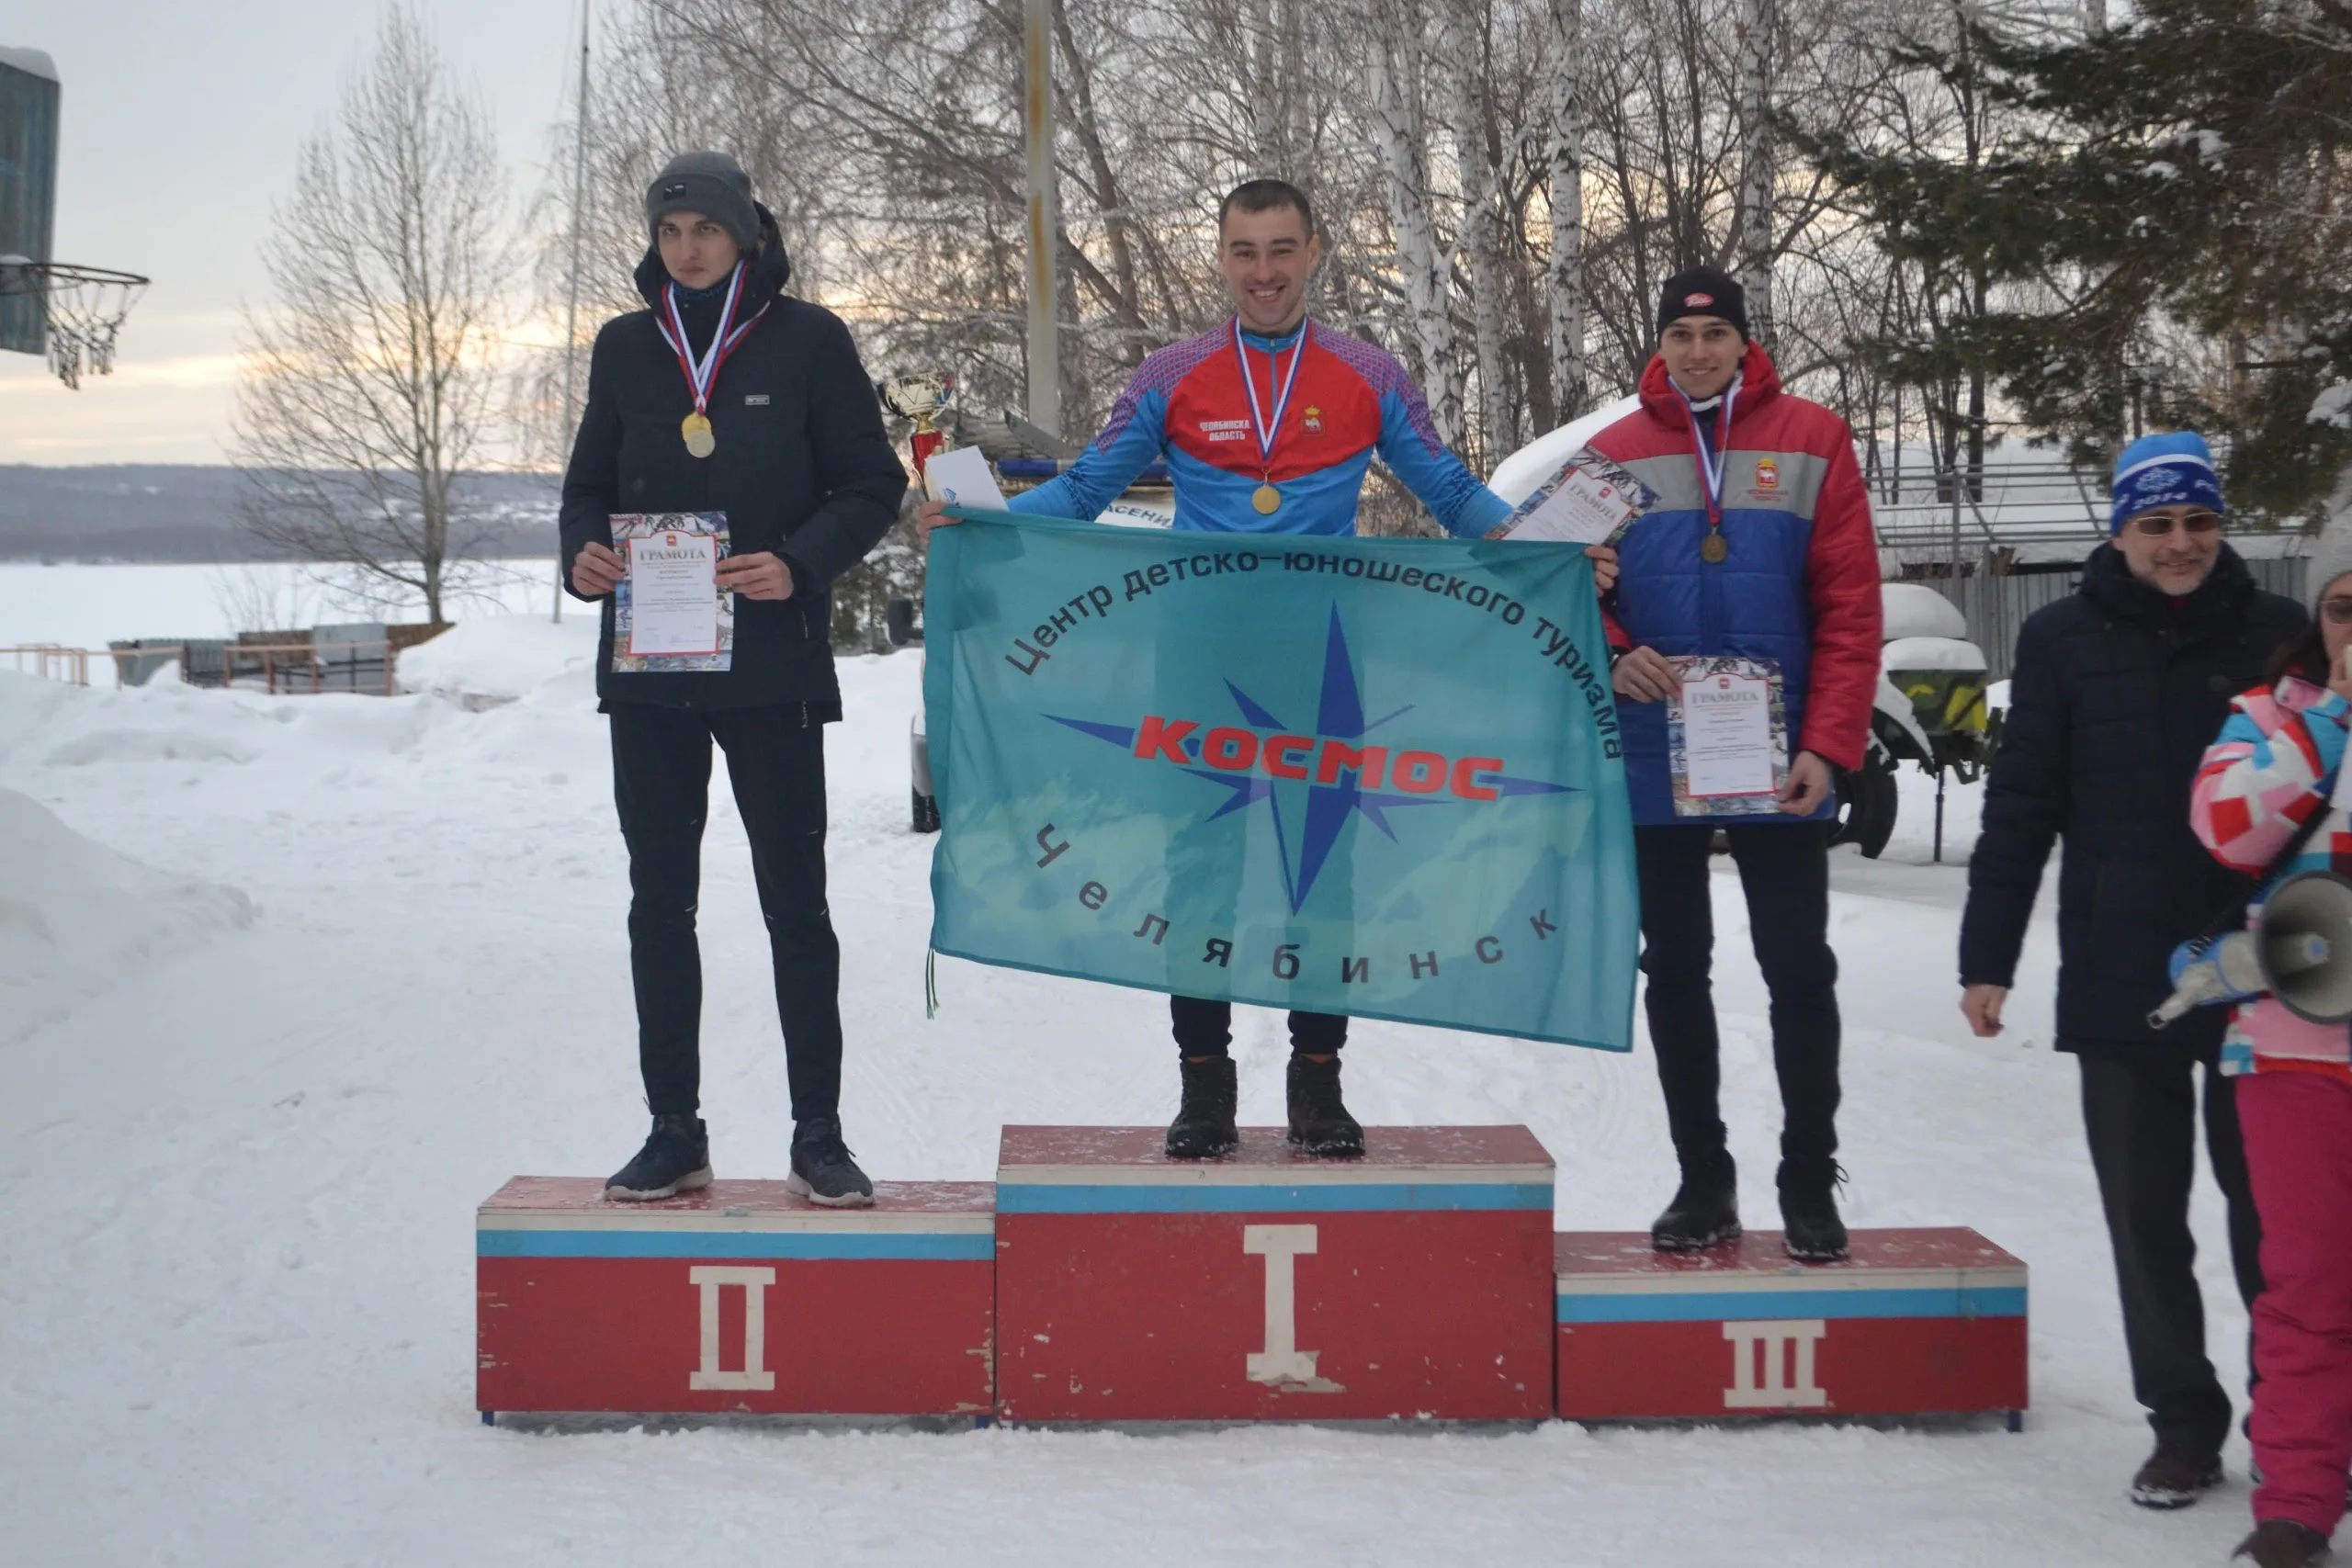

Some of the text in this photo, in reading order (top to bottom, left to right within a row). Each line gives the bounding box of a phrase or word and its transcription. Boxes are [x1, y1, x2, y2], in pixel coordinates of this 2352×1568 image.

[1199, 420, 1250, 432] ЧЕЛЯБИНСКА
[1208, 431, 1246, 442] ОБЛАСТЬ
[1569, 482, 1617, 522] ГРАМОТА
[639, 548, 707, 561] ГРАМОТА
[1004, 584, 1113, 675] Центр
[1123, 551, 1525, 626] детско-юношеского
[1532, 616, 1622, 760] туризма
[1691, 692, 1759, 705] ГРАМОТА
[1134, 715, 1504, 802] КОСМОС
[1036, 823, 1557, 983] Челябинск
[690, 1265, 775, 1391] II
[1723, 1319, 1826, 1408] III
